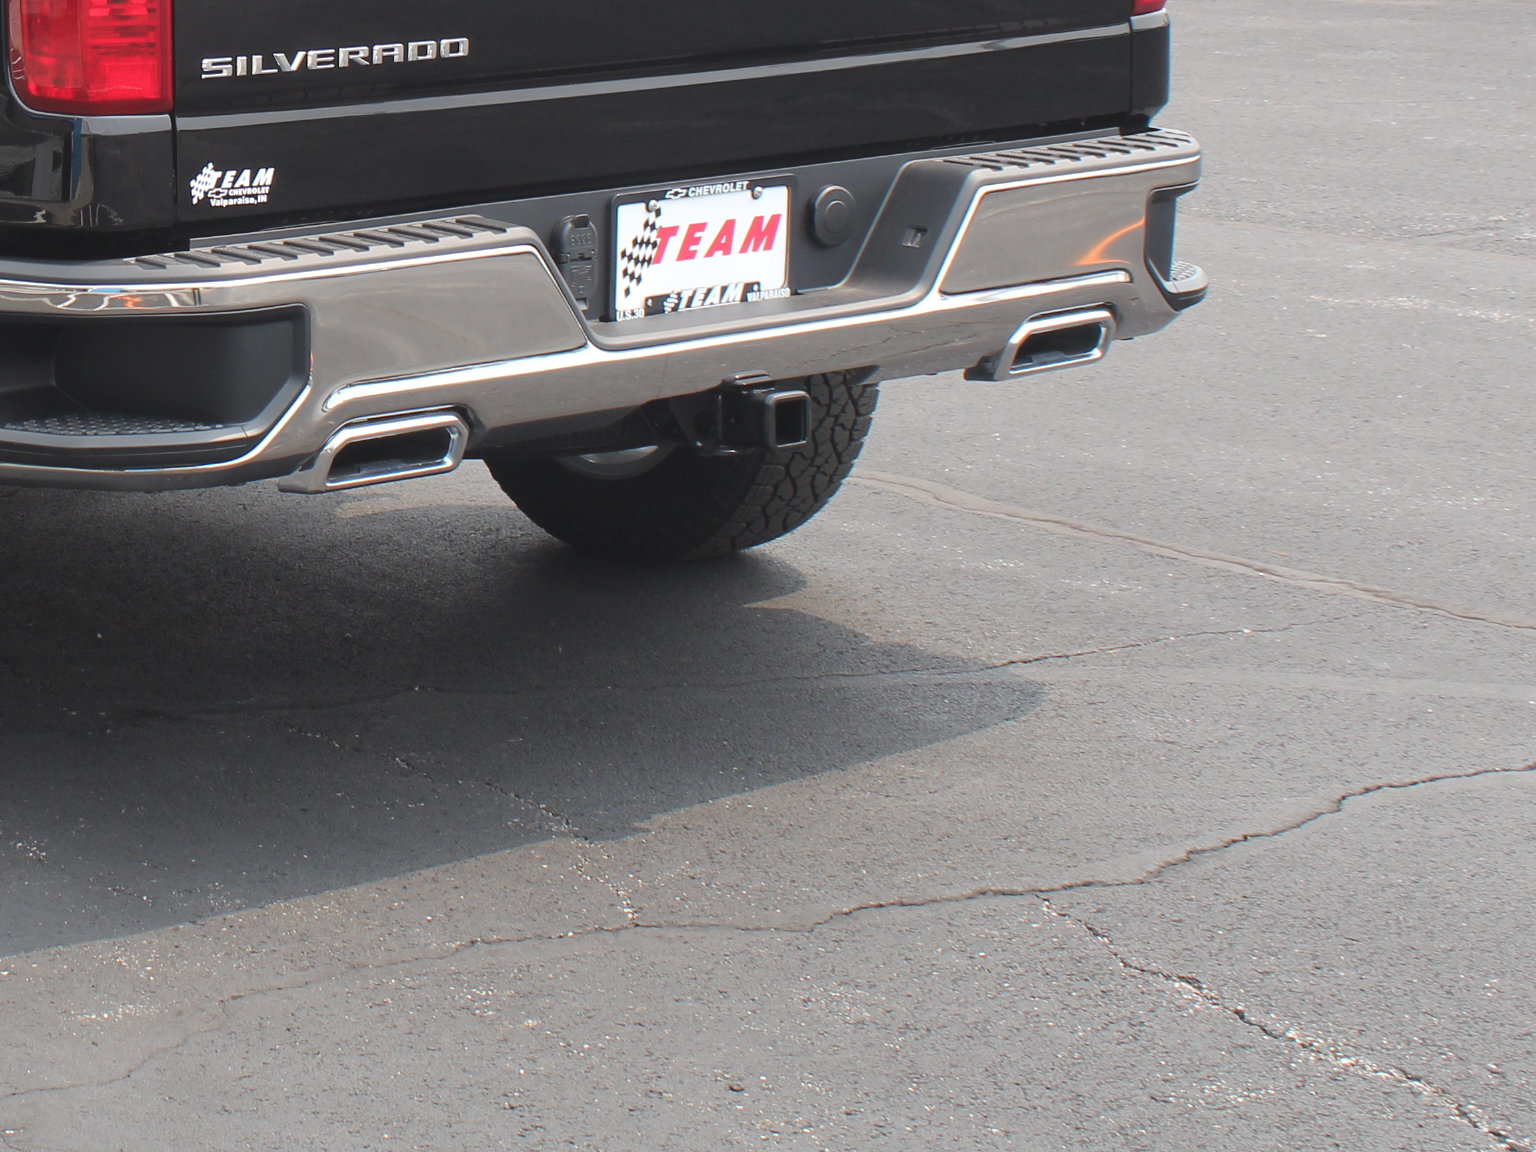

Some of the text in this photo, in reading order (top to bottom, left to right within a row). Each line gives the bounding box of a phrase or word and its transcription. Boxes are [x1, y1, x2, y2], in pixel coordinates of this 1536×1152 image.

[201, 36, 470, 79] SILVERADO
[209, 168, 275, 188] TEAM
[229, 187, 270, 196] CHEVROLET
[687, 180, 750, 198] CHEVROLET
[651, 213, 782, 264] TEAM
[677, 282, 746, 310] TEAM
[746, 287, 791, 302] VALPARAISO
